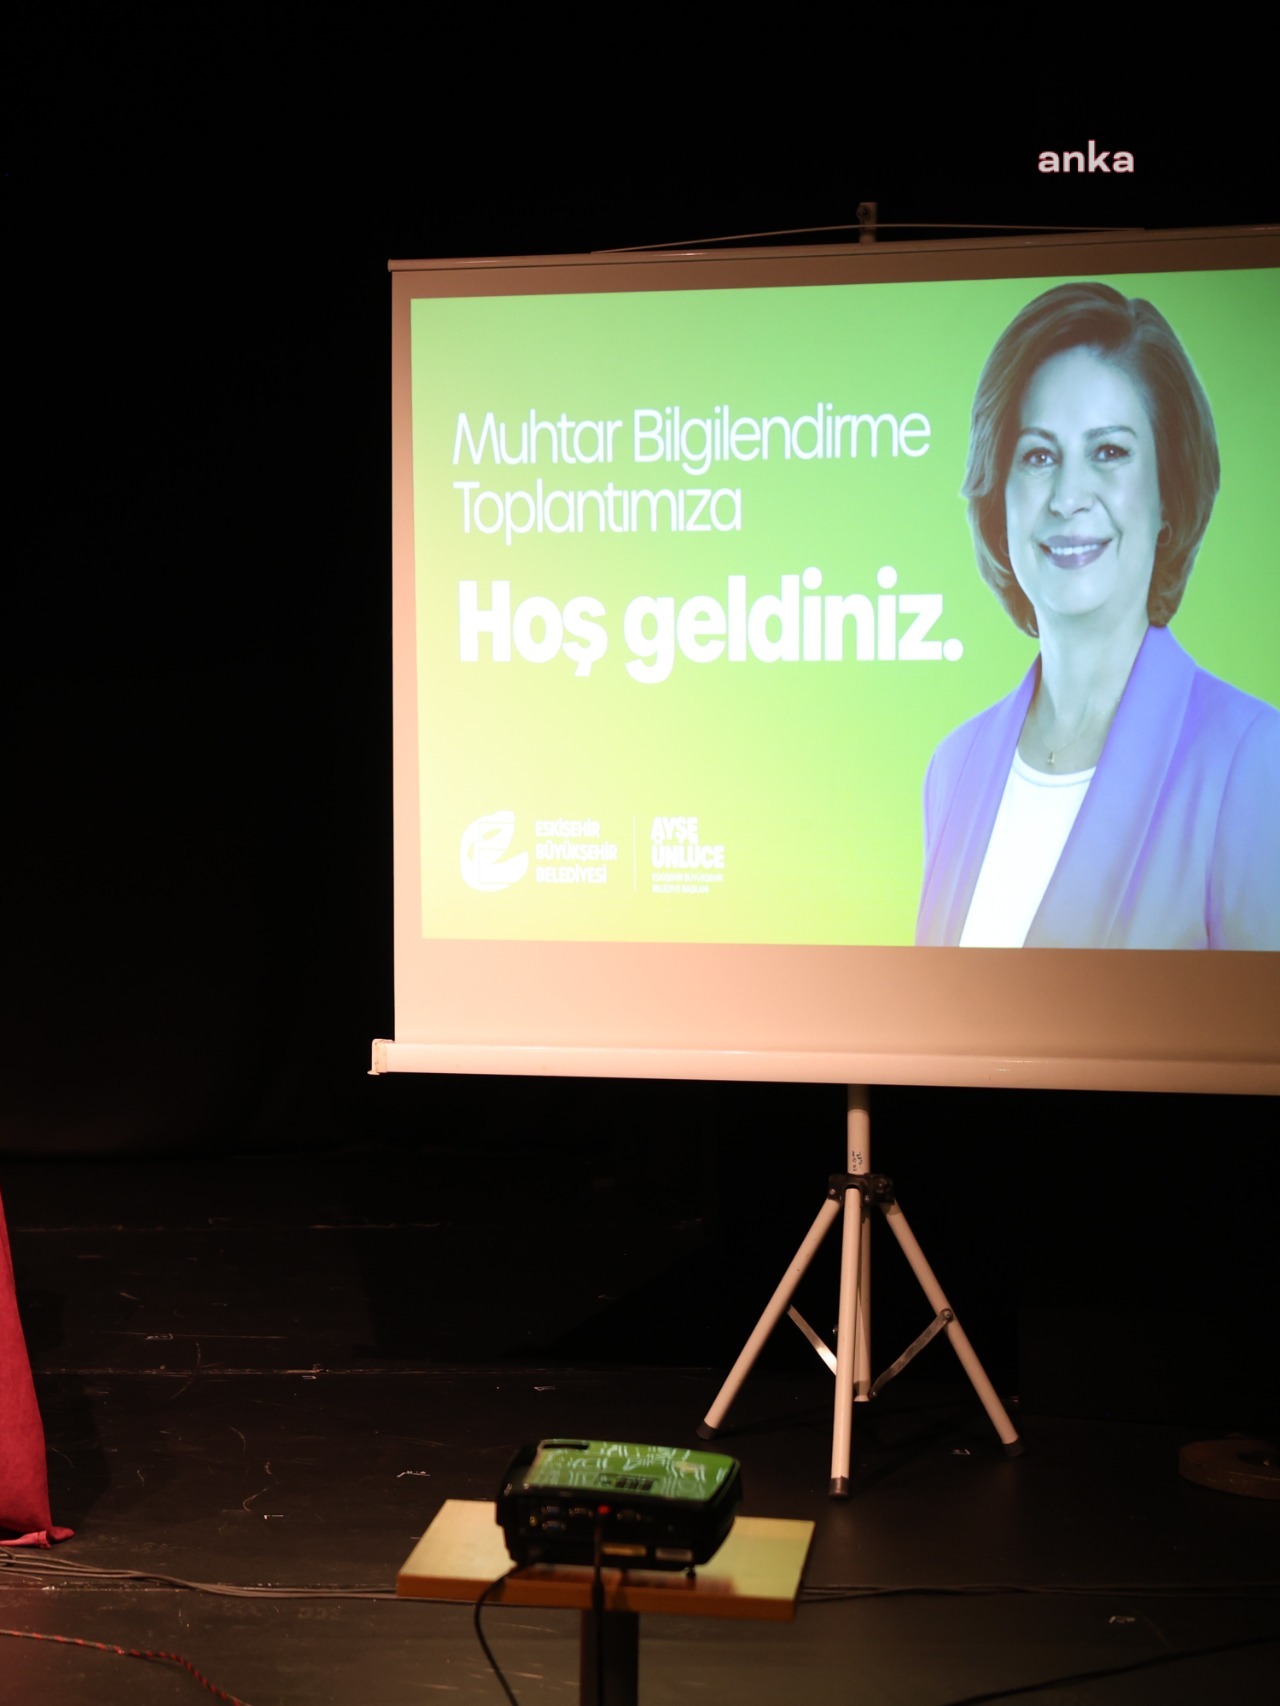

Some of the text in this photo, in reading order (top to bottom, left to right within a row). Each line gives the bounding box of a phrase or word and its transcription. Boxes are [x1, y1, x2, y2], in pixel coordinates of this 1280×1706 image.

[451, 402, 932, 476] Muhtar Bilgilendirme
[452, 478, 742, 546] Toplantımıza
[458, 565, 964, 685] Hoş geldiniz.
